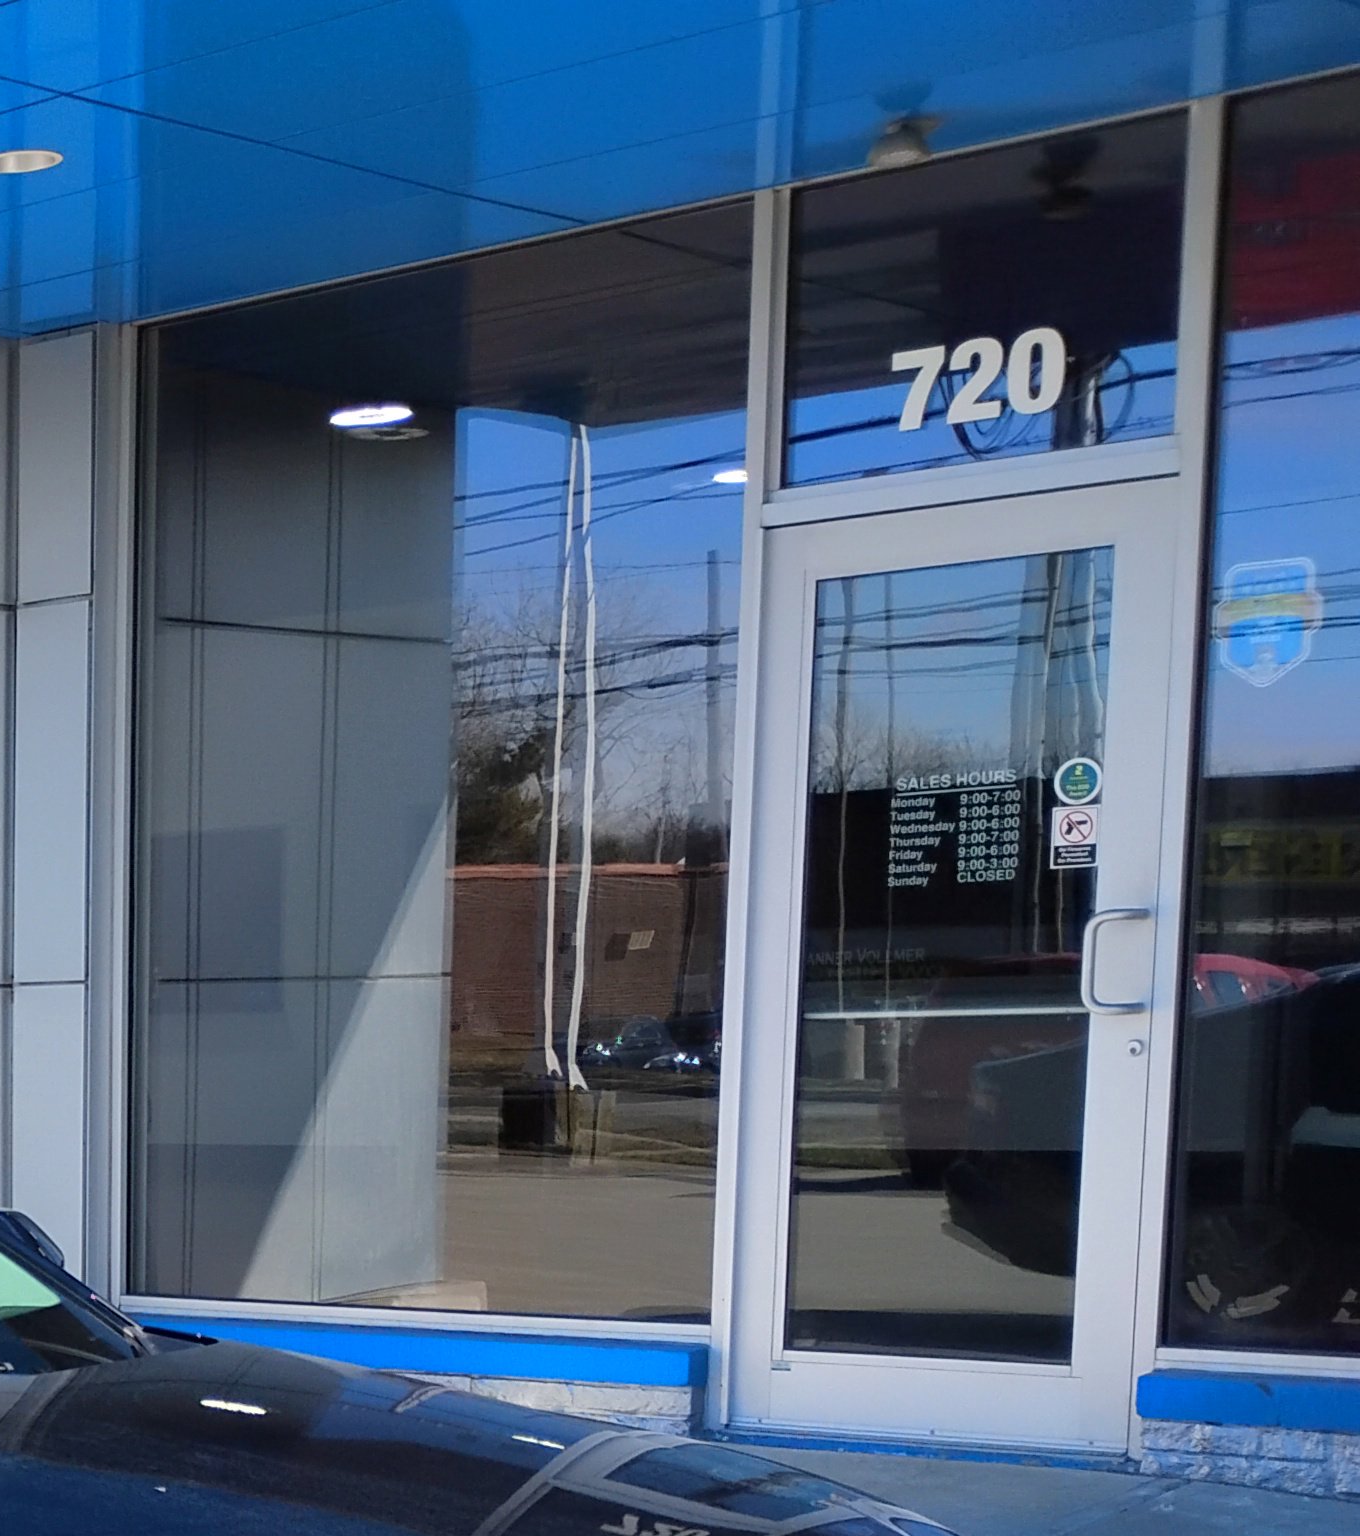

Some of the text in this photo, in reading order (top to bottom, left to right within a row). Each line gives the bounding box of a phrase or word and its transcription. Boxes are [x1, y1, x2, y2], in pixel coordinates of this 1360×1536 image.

[891, 327, 1066, 433] 720
[896, 769, 1017, 791] SALES HOURS
[891, 789, 1021, 808] Monday 9:00-7:00
[890, 803, 1020, 821] Tuesday 9:00-6:00
[890, 817, 1020, 834] Wednesday 9:00-6:00
[889, 830, 1020, 848] Thursday 9:00-7:00
[888, 843, 1019, 861] Friday 9:00-6:00
[888, 856, 1019, 874] Saturday 9:00-3:00
[887, 869, 1016, 888] Sunday CLOSED
